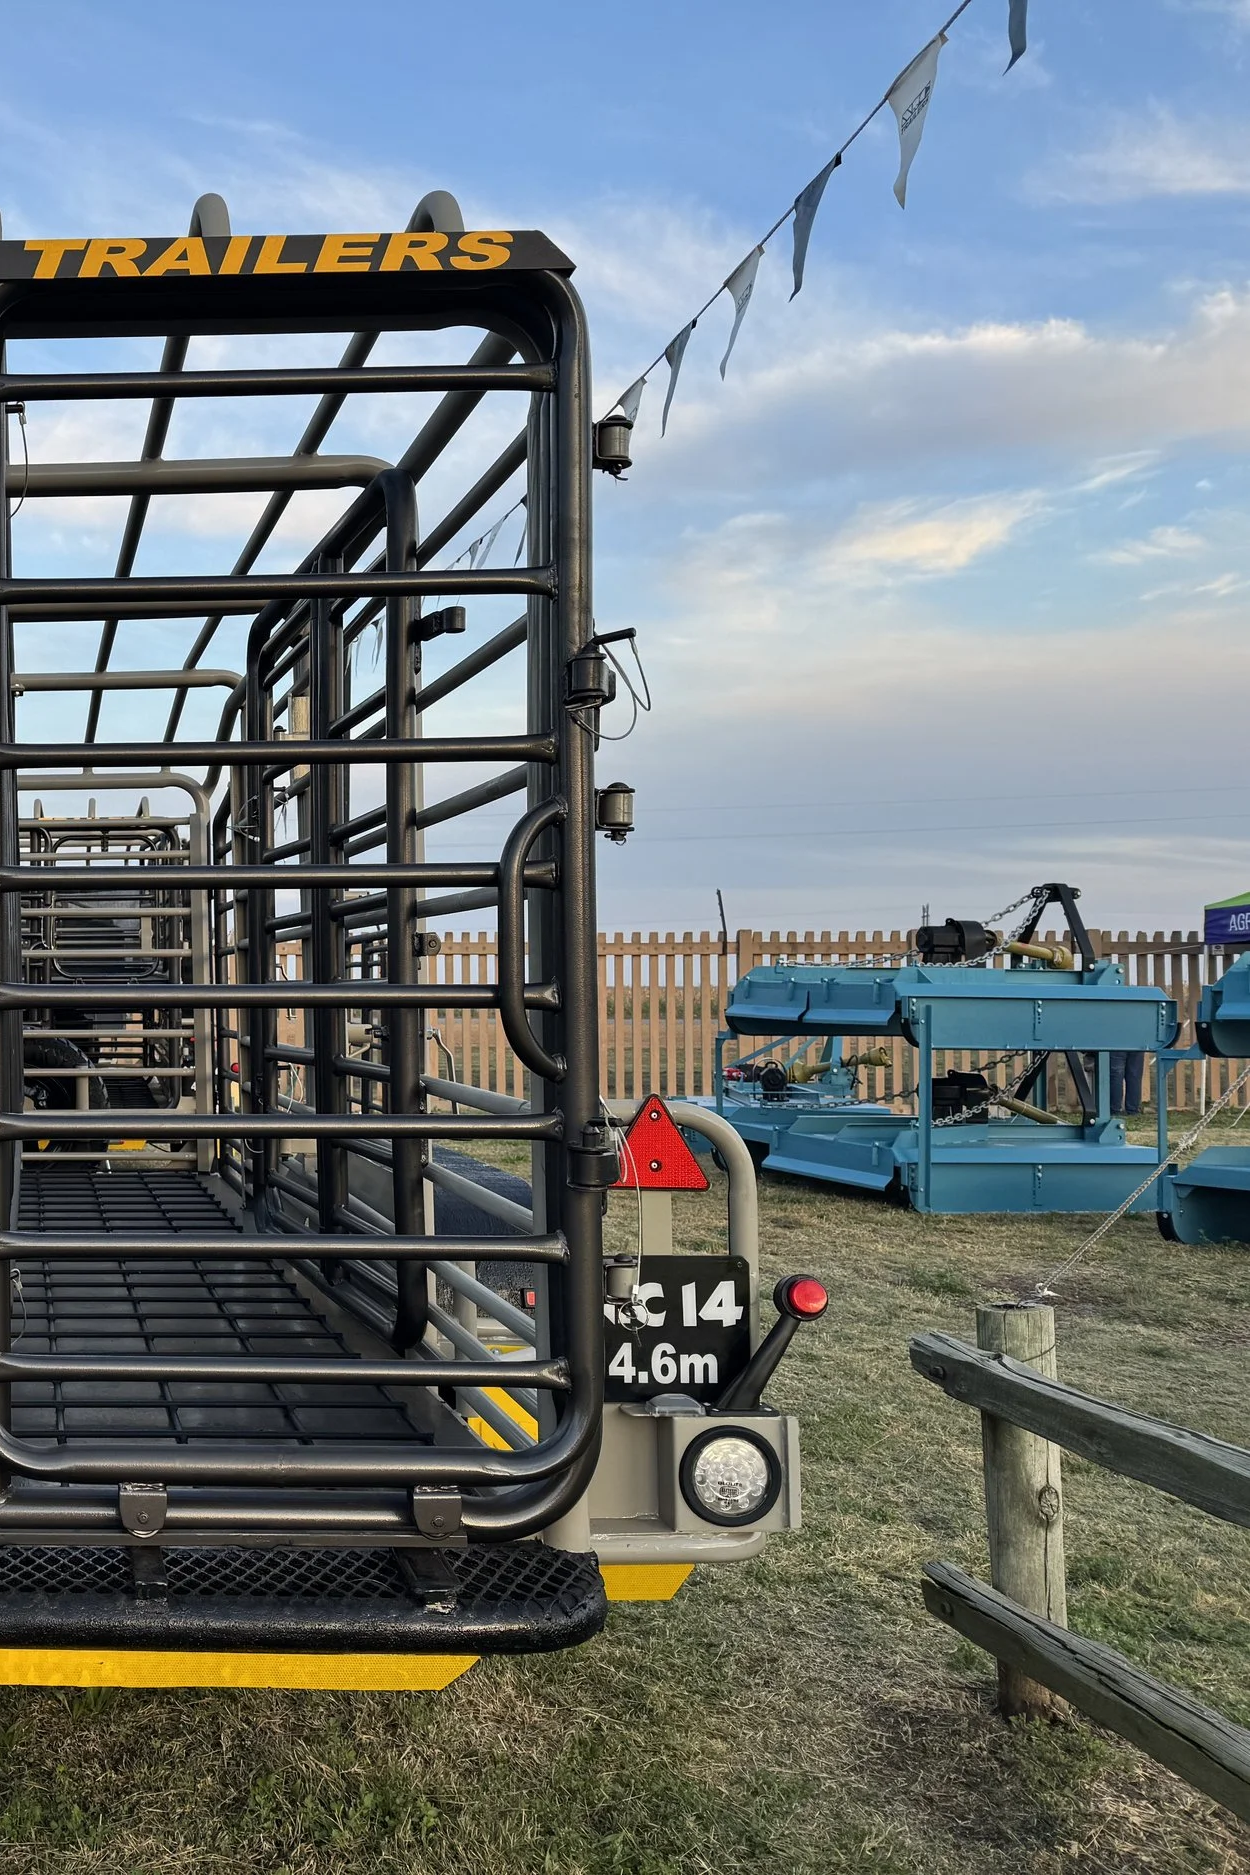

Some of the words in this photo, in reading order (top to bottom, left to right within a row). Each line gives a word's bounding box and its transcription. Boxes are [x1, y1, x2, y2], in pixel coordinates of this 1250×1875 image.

[24, 231, 513, 279] TRAILERS
[682, 1280, 744, 1328] 14
[608, 1342, 719, 1385] 4.6m
